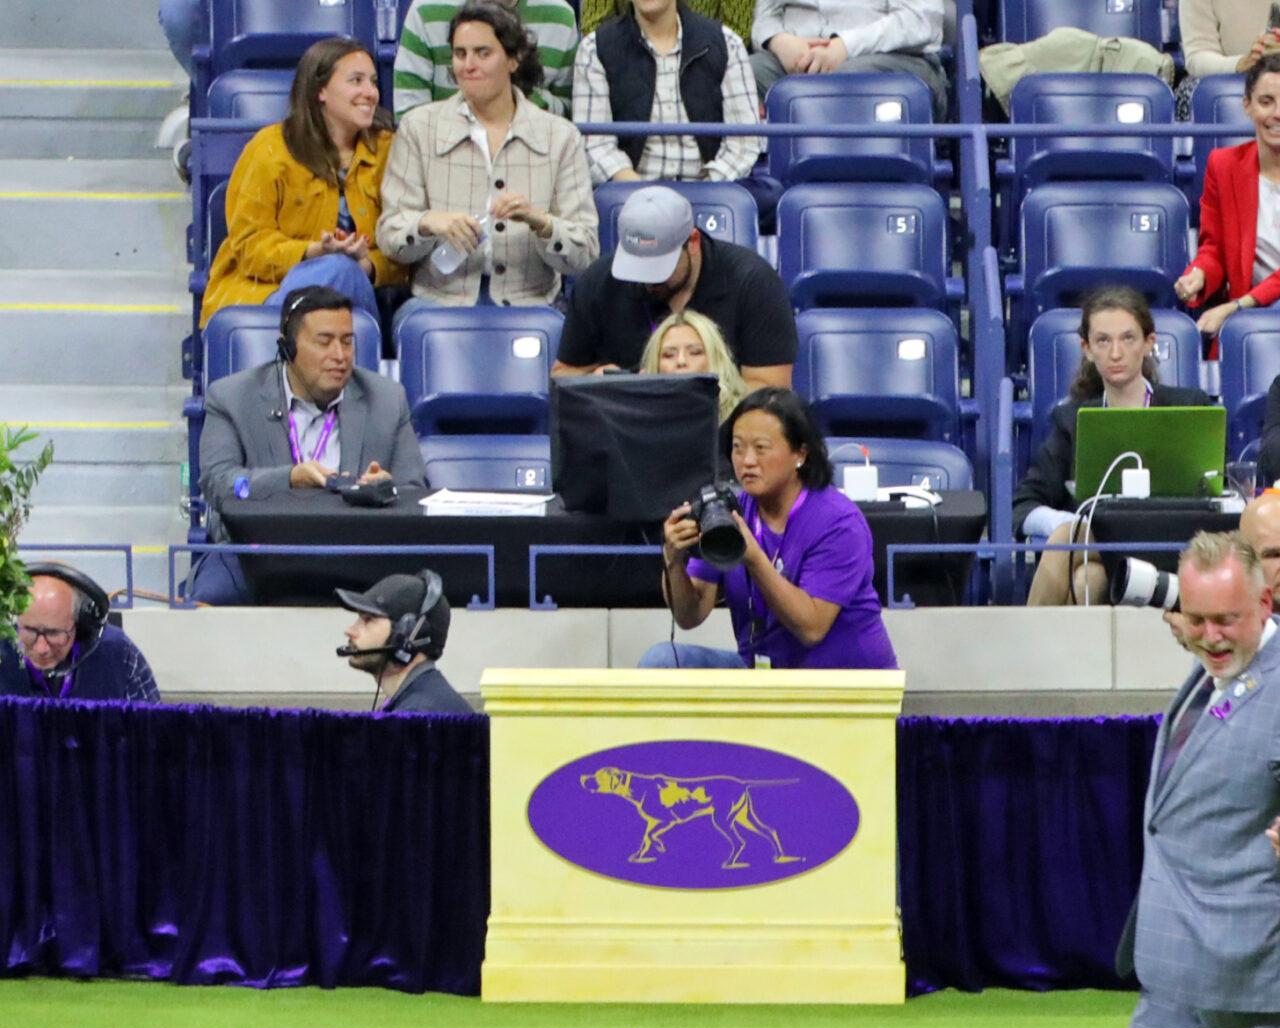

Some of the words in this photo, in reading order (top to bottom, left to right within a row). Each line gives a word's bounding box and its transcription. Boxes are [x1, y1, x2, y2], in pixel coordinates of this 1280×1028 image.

[705, 214, 718, 232] 6
[896, 216, 907, 233] 5
[1140, 214, 1150, 231] 5
